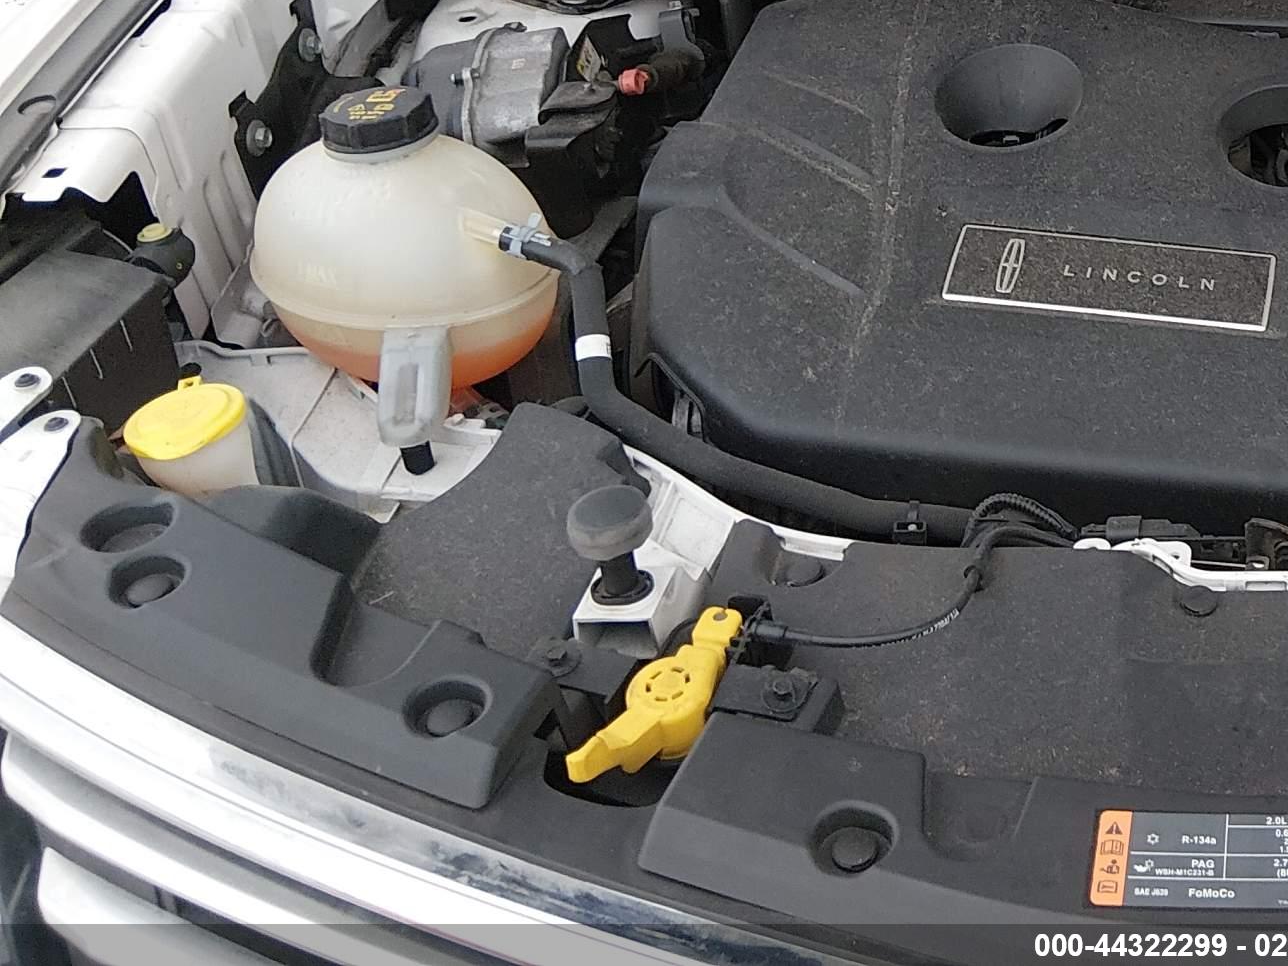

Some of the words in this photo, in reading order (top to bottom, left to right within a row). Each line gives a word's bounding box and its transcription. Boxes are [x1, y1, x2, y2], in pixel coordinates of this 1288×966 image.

[1064, 265, 1215, 290] LINCOLN
[1266, 816, 1287, 824] 2.0L
[1182, 835, 1216, 844] R-134a
[1192, 859, 1214, 868] PAG
[1273, 859, 1288, 867] 2.7
[1189, 888, 1235, 898] FoMoCo
